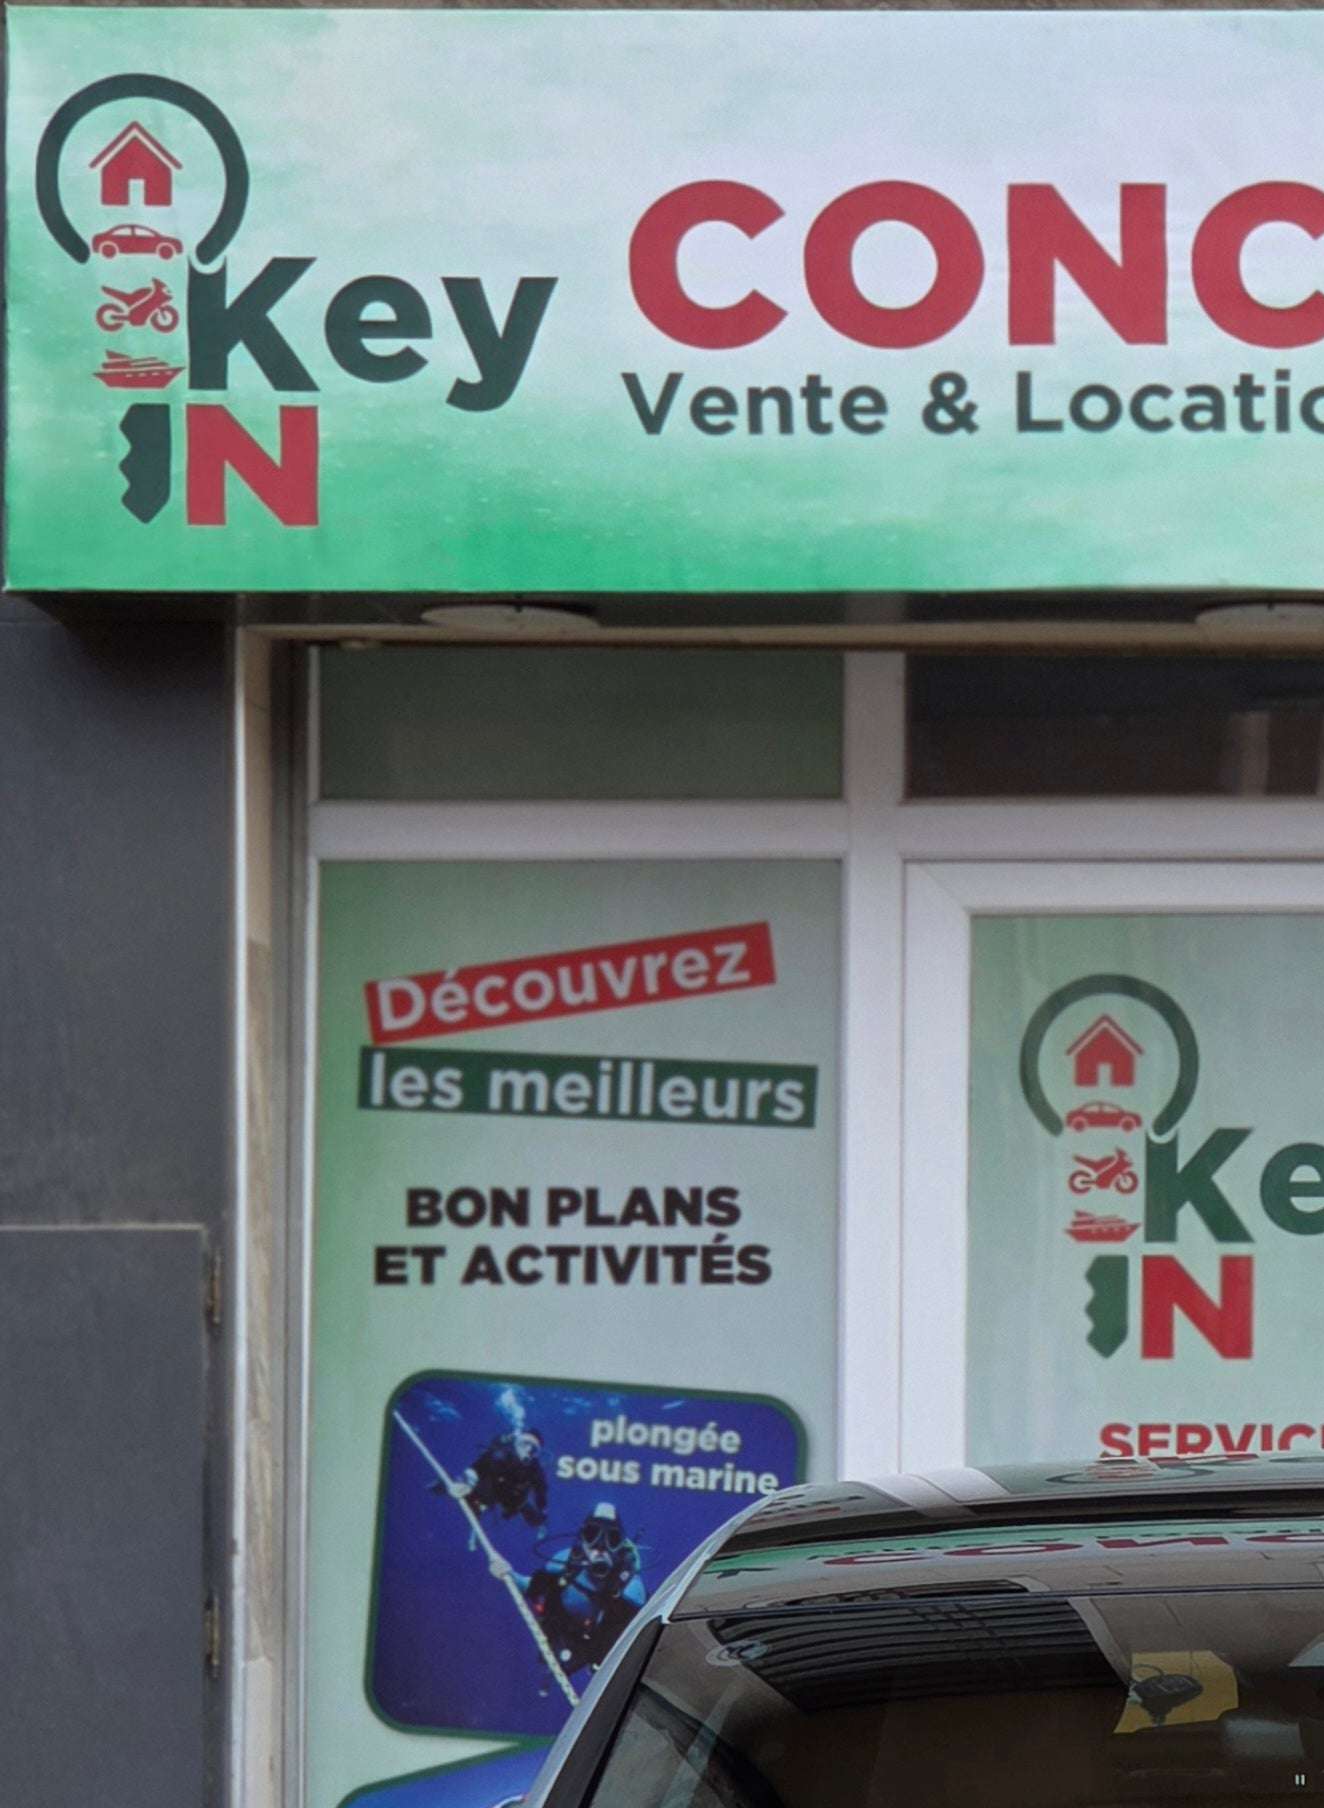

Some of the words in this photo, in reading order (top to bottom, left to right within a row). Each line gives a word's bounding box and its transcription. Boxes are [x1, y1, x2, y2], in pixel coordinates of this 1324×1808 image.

[186, 256, 559, 412] Key
[621, 372, 888, 436] Vente
[921, 371, 979, 436] &
[376, 940, 751, 1032] Découvrez
[370, 1052, 464, 1109] les
[487, 1060, 805, 1122] meilleurs
[406, 1186, 530, 1228] BON
[547, 1186, 742, 1228] PLANS
[374, 1245, 447, 1286] ET
[461, 1232, 772, 1286] ACTIVITÉS
[590, 1414, 742, 1457] plongée
[556, 1454, 642, 1485] sous
[650, 1462, 780, 1496] marine
